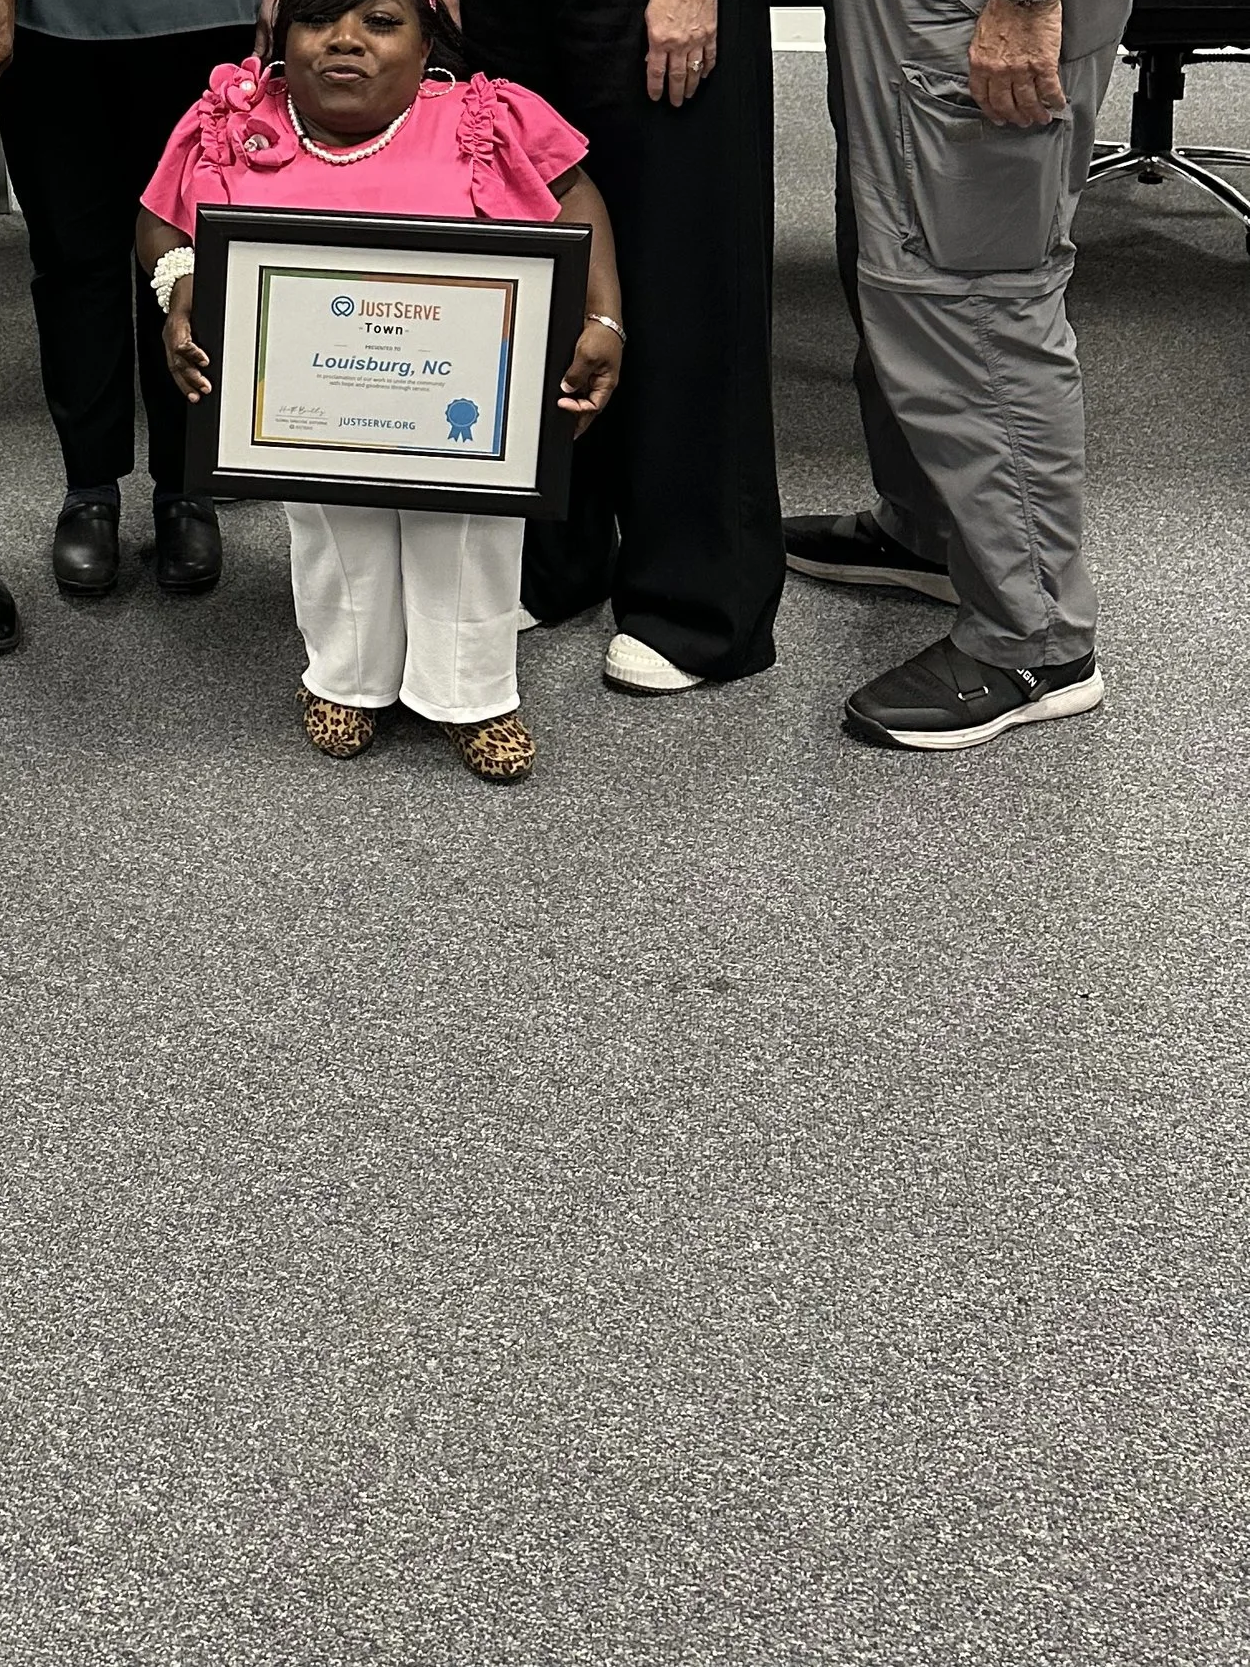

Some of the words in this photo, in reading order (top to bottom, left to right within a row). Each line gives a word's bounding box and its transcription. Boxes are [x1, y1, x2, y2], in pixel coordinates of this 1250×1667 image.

[358, 299, 441, 321] JUSTSERVE
[312, 352, 415, 377] Louisburg,
[422, 360, 452, 376] NC
[338, 417, 416, 430] JUSTSERVE.ORG
